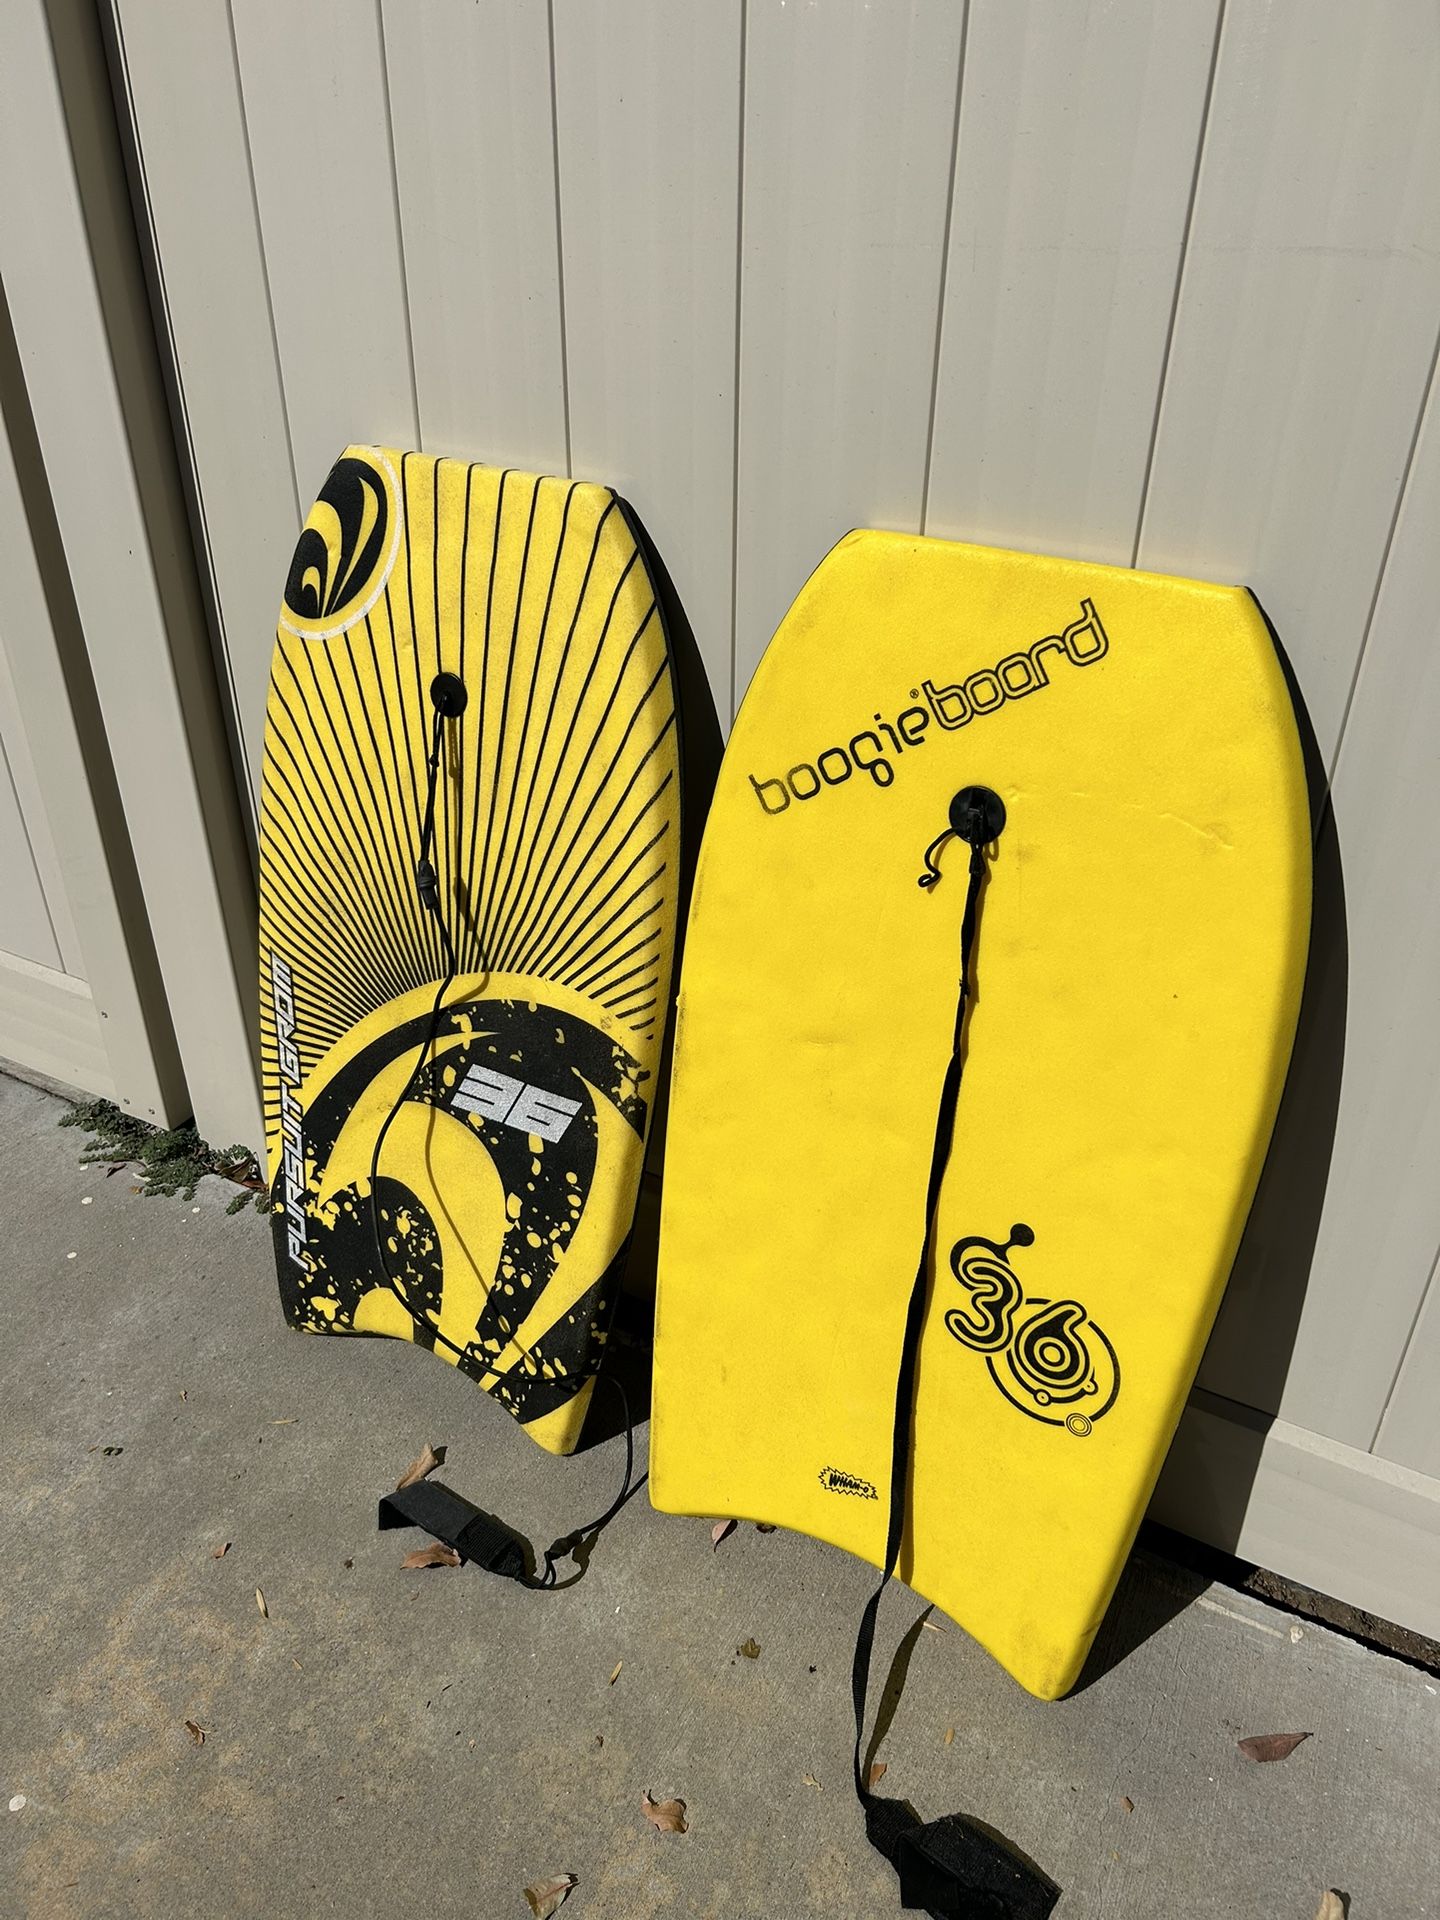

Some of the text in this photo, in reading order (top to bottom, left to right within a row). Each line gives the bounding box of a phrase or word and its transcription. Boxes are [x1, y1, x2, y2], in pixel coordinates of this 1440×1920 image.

[922, 597, 1109, 730] board
[271, 951, 309, 1271] PURSUIT GROM
[450, 1063, 583, 1144] 36
[945, 1240, 1090, 1390] 36
